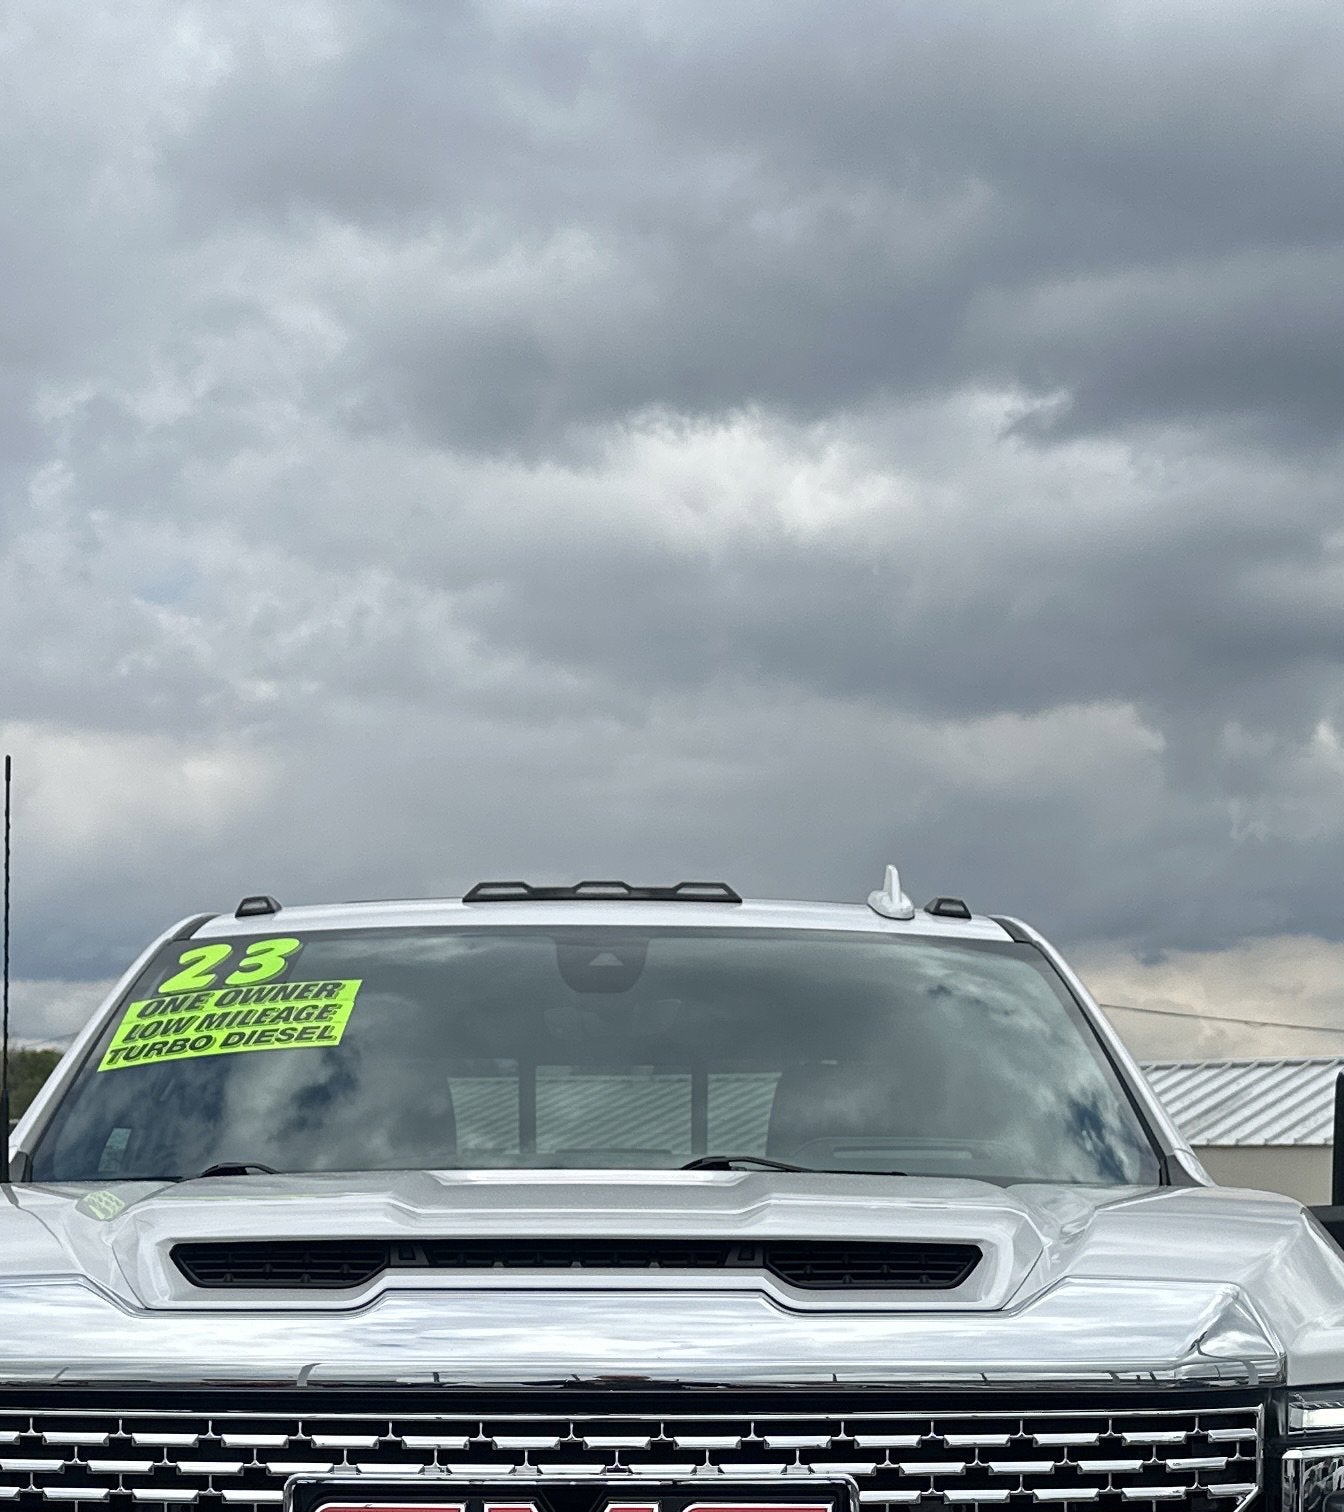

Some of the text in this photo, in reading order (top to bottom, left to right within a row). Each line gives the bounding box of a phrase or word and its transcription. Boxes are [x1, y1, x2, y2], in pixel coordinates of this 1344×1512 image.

[158, 938, 302, 994] 23
[136, 981, 344, 1020] ONE OWNER
[122, 1003, 343, 1043] LOW MILEAGE
[106, 1025, 338, 1065] TURBO DIESEL
